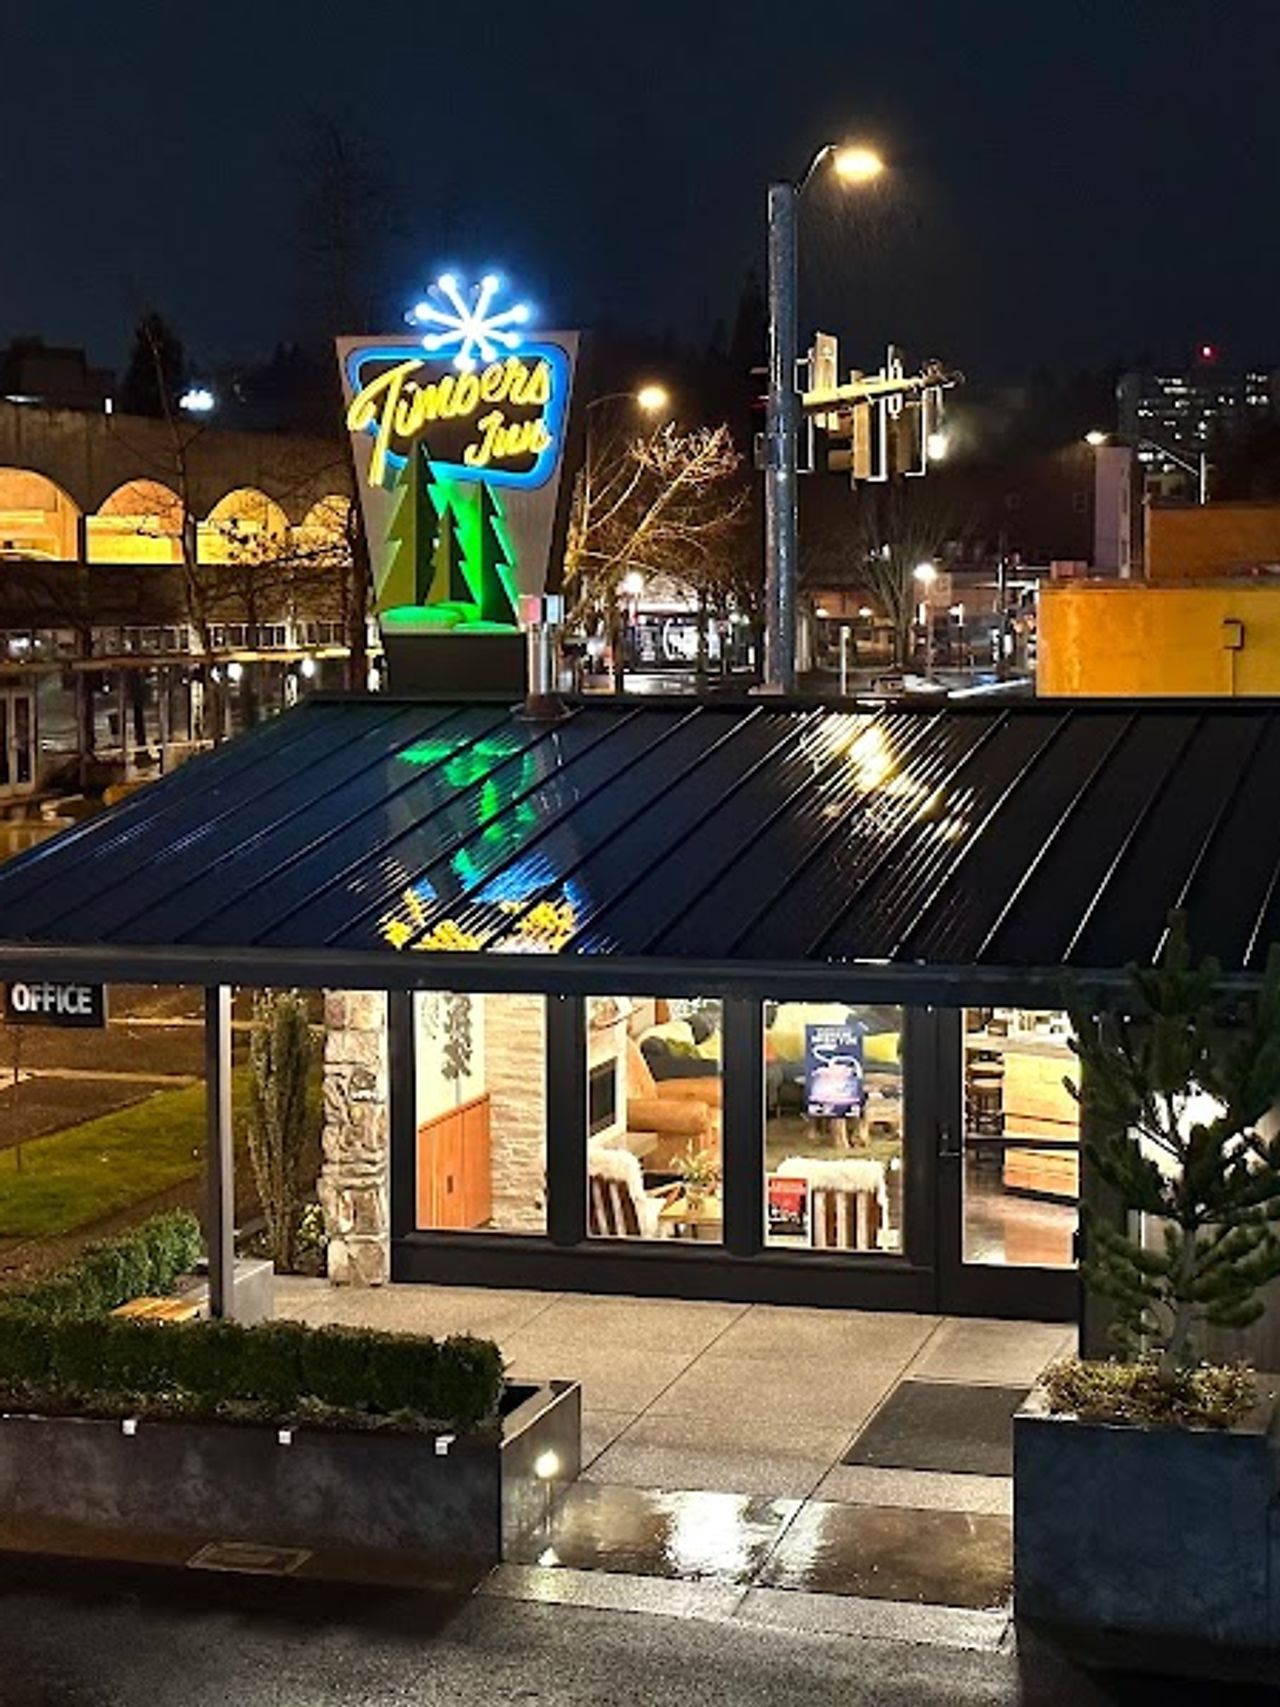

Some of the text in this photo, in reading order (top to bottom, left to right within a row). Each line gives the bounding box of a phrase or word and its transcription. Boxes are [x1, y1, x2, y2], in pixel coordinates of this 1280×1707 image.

[347, 355, 551, 487] Timbers
[463, 409, 553, 467] Inn
[11, 982, 93, 1014] OFFICE
